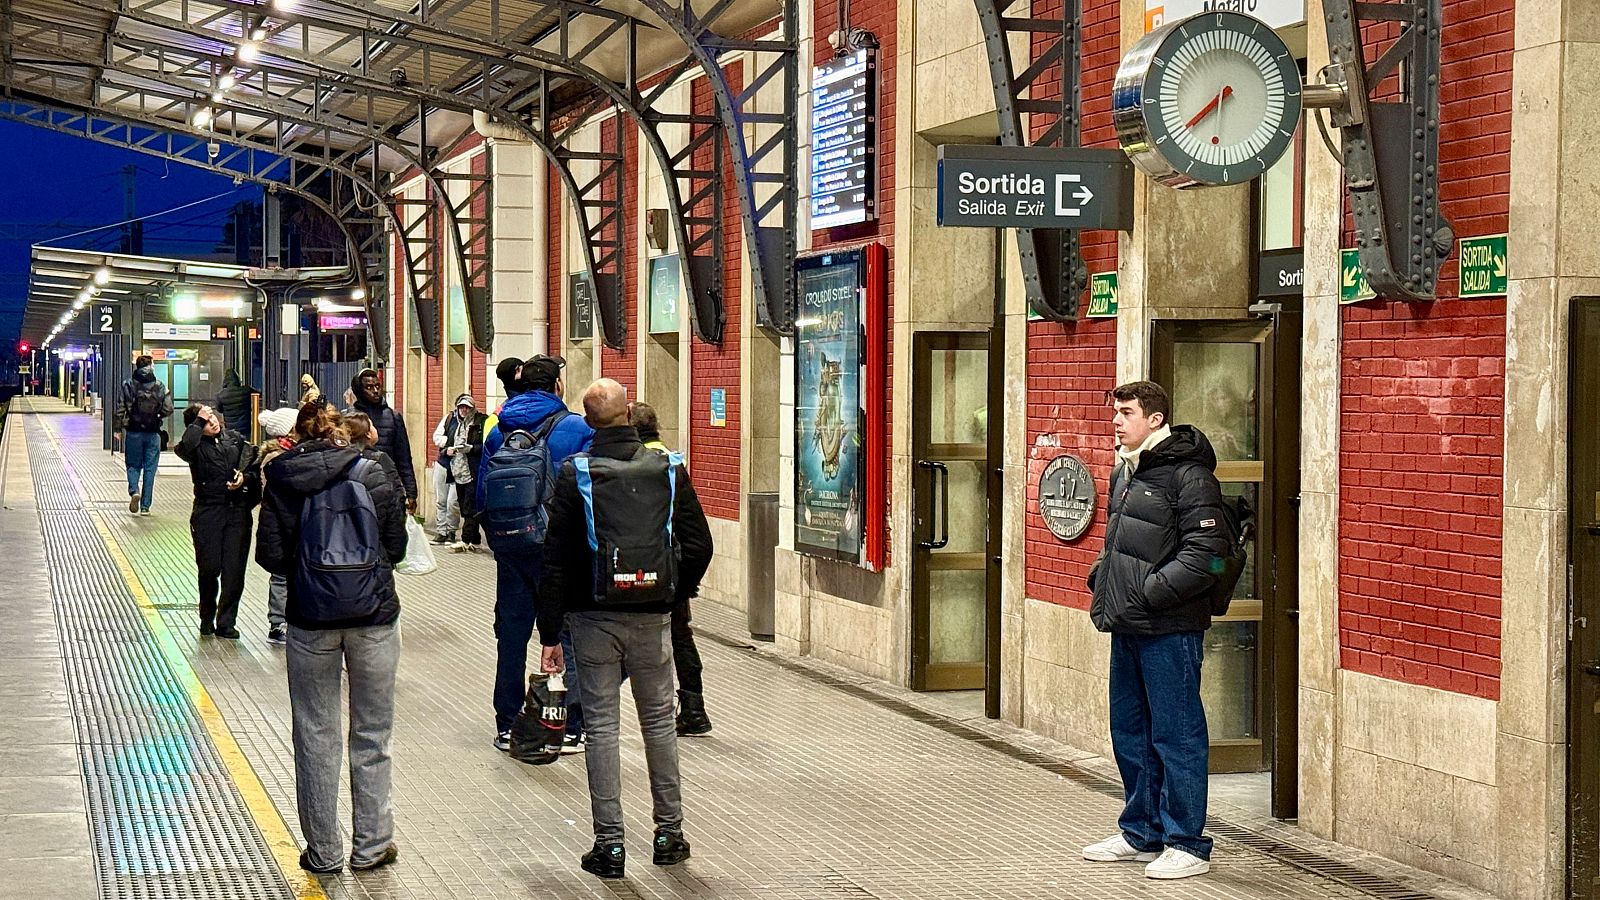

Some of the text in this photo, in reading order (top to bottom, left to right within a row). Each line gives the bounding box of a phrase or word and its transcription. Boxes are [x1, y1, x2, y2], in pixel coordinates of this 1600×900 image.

[1216, 13, 1223, 27] 12
[1179, 26, 1189, 39] 11
[1251, 22, 1259, 35] 1
[1277, 50, 1289, 61] 2
[1153, 57, 1165, 68] 10
[1280, 129, 1291, 137] 4
[1156, 135, 1168, 145] 8
[1186, 160, 1195, 173] 7
[1257, 157, 1266, 169] 5
[1223, 168, 1229, 182] 6
[958, 171, 1046, 195] Sortida
[958, 199, 1046, 216] Salida Exit
[1462, 245, 1493, 268] SORTIDA
[1278, 268, 1304, 287] Sorti
[1463, 270, 1491, 291] SALIDA
[1093, 279, 1110, 296] SORTIDA
[100, 306, 113, 314] via
[1091, 298, 1109, 313] SALIDA
[100, 314, 113, 332] 2
[613, 569, 658, 582] IRONMAN
